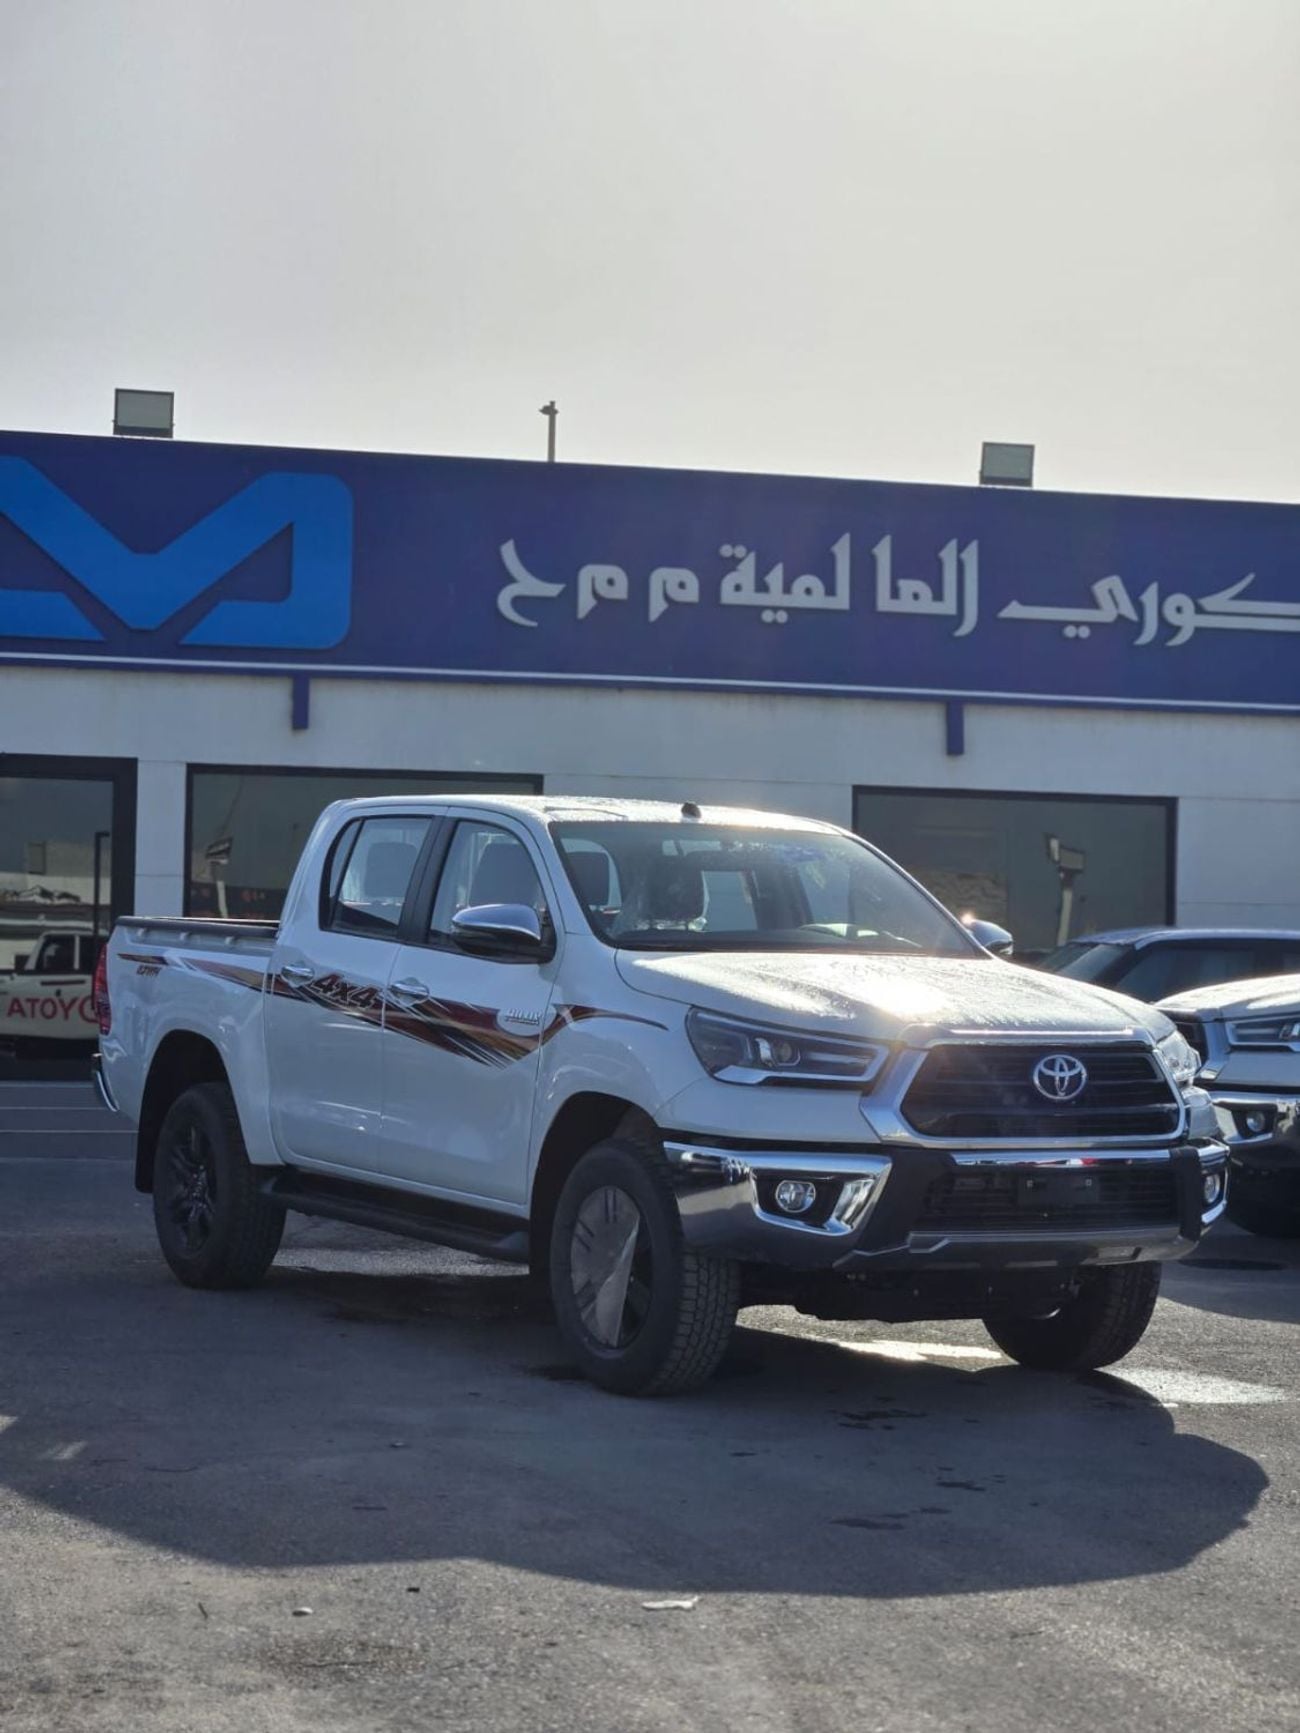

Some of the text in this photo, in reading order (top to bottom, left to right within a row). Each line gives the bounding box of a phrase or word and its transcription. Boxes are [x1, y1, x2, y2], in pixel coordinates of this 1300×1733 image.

[497, 539, 566, 626] ح
[577, 564, 628, 619] م
[649, 567, 699, 622] م
